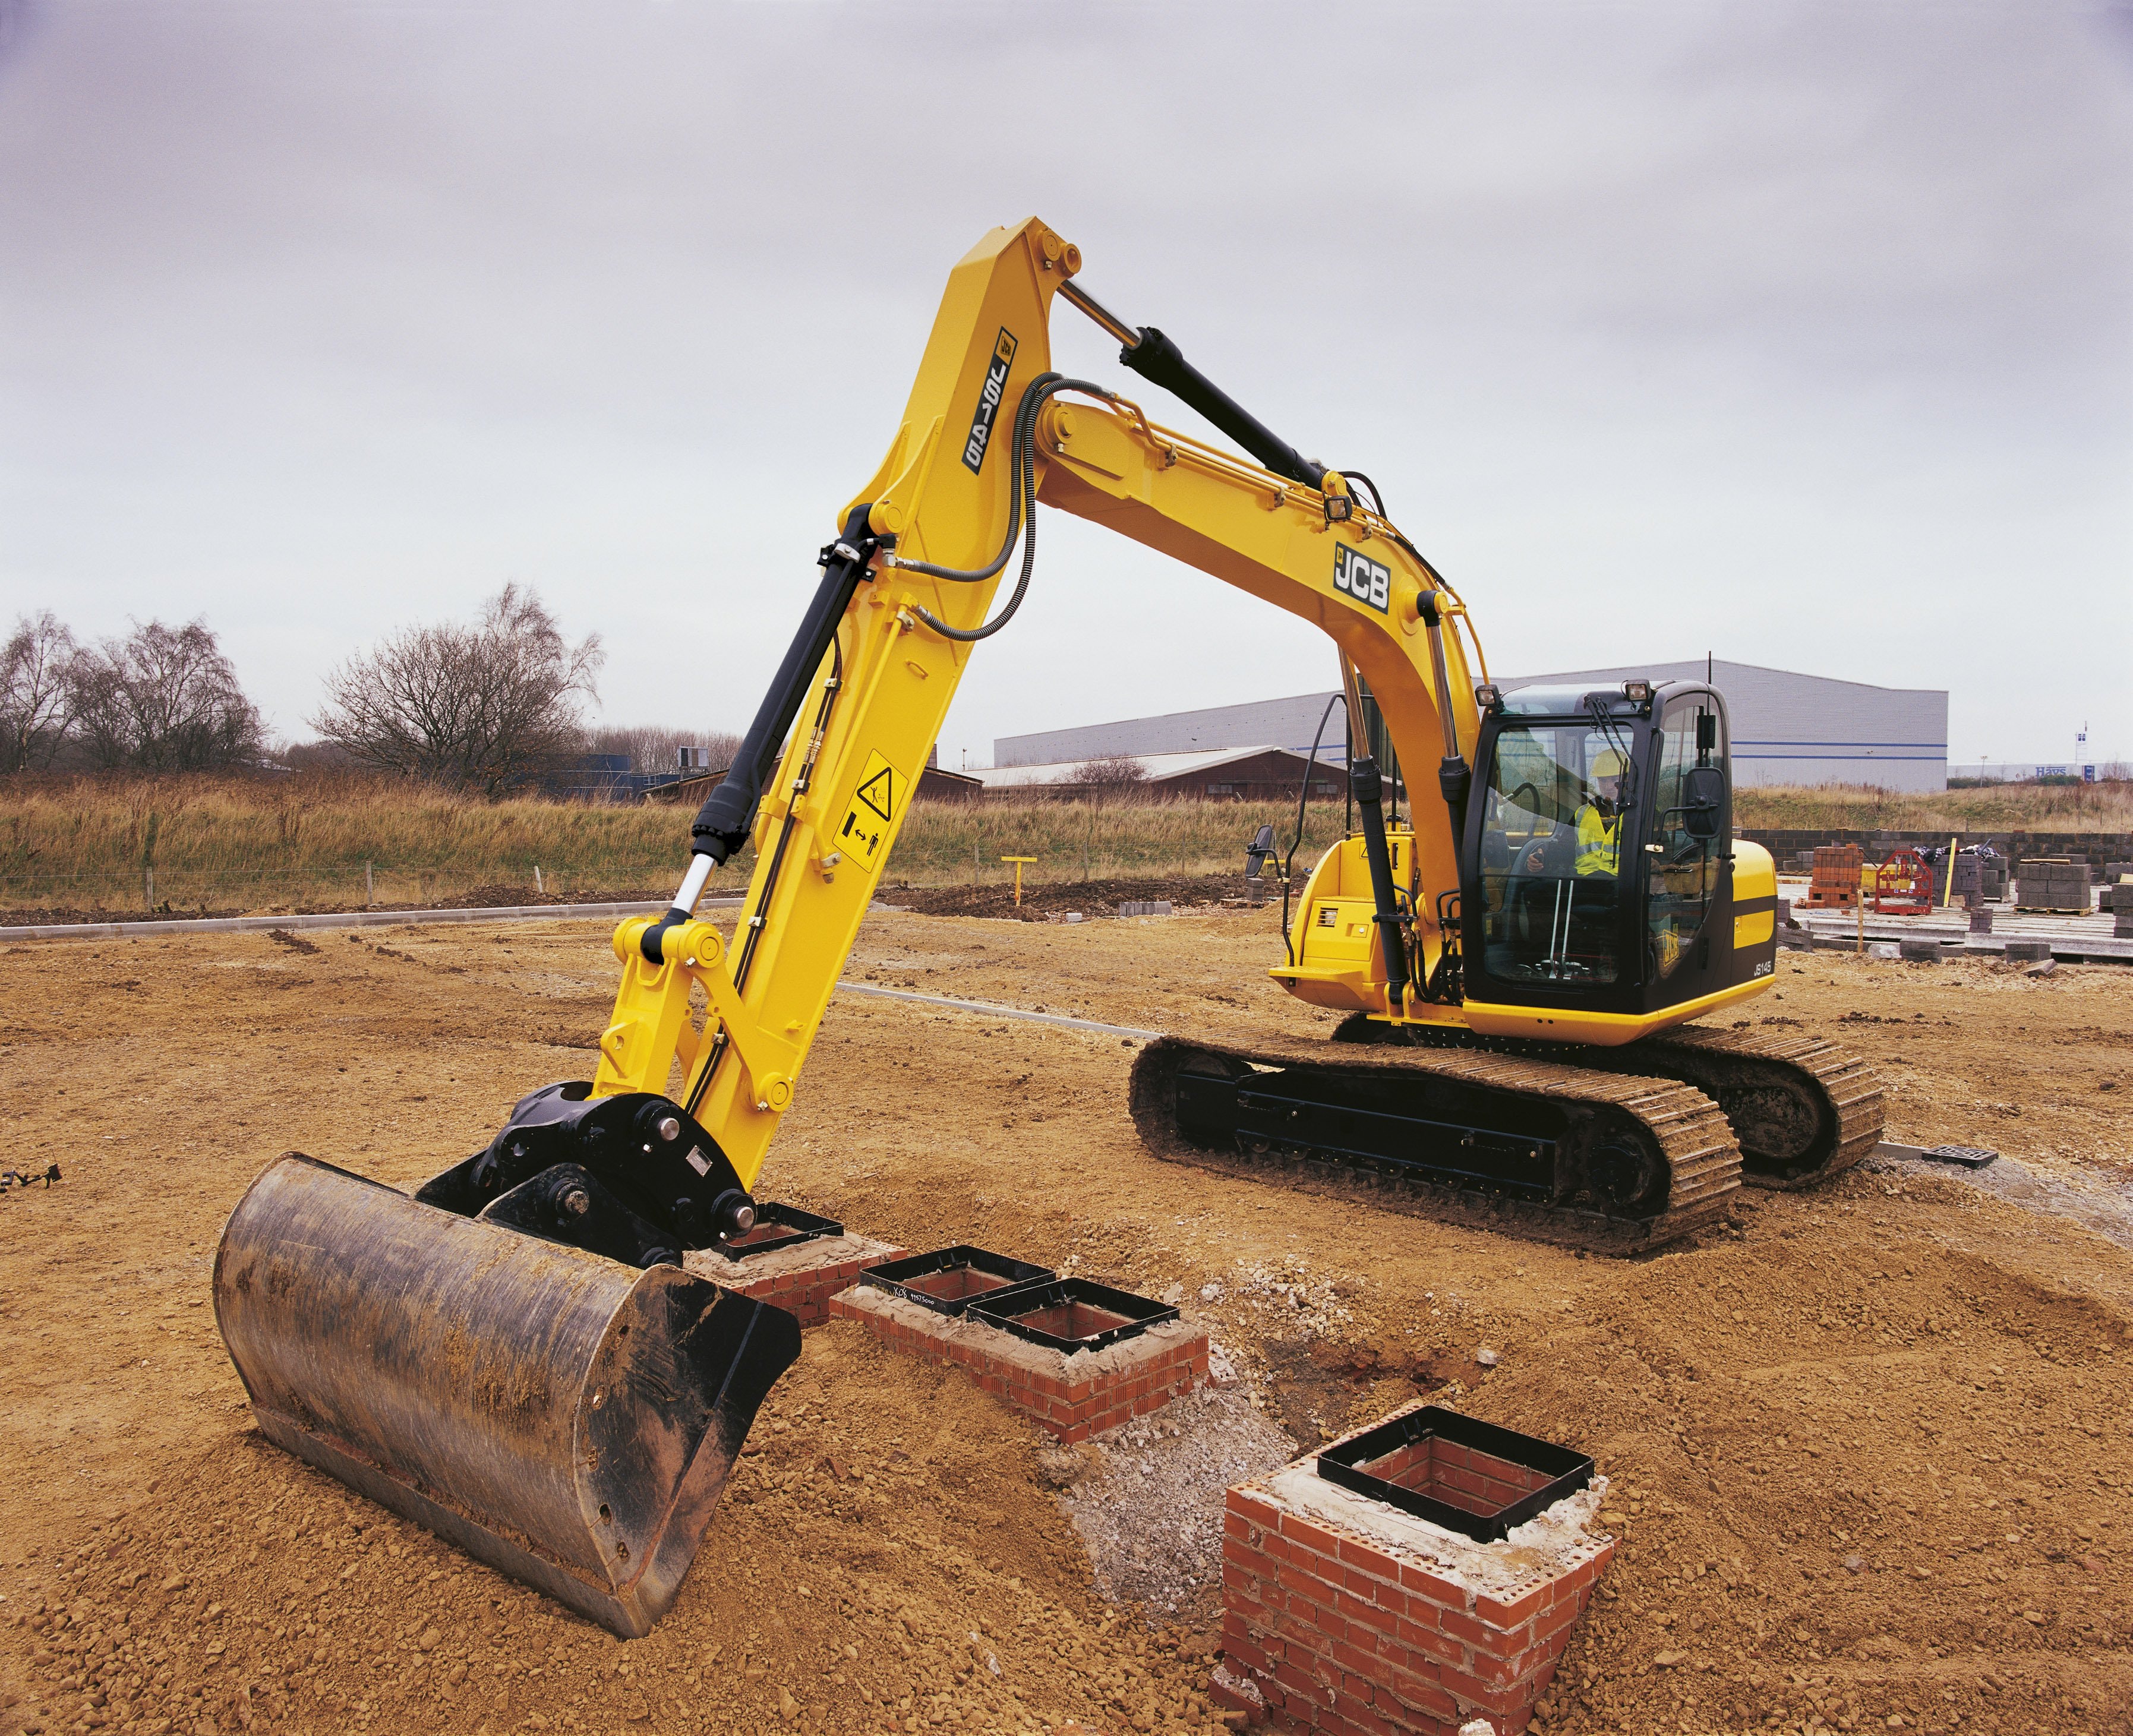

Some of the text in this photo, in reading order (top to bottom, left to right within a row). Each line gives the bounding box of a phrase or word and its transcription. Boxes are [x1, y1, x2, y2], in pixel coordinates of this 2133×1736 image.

[966, 364, 1006, 467] JS145
[1335, 551, 1389, 609] JCB
[1754, 961, 1771, 976] JS145
